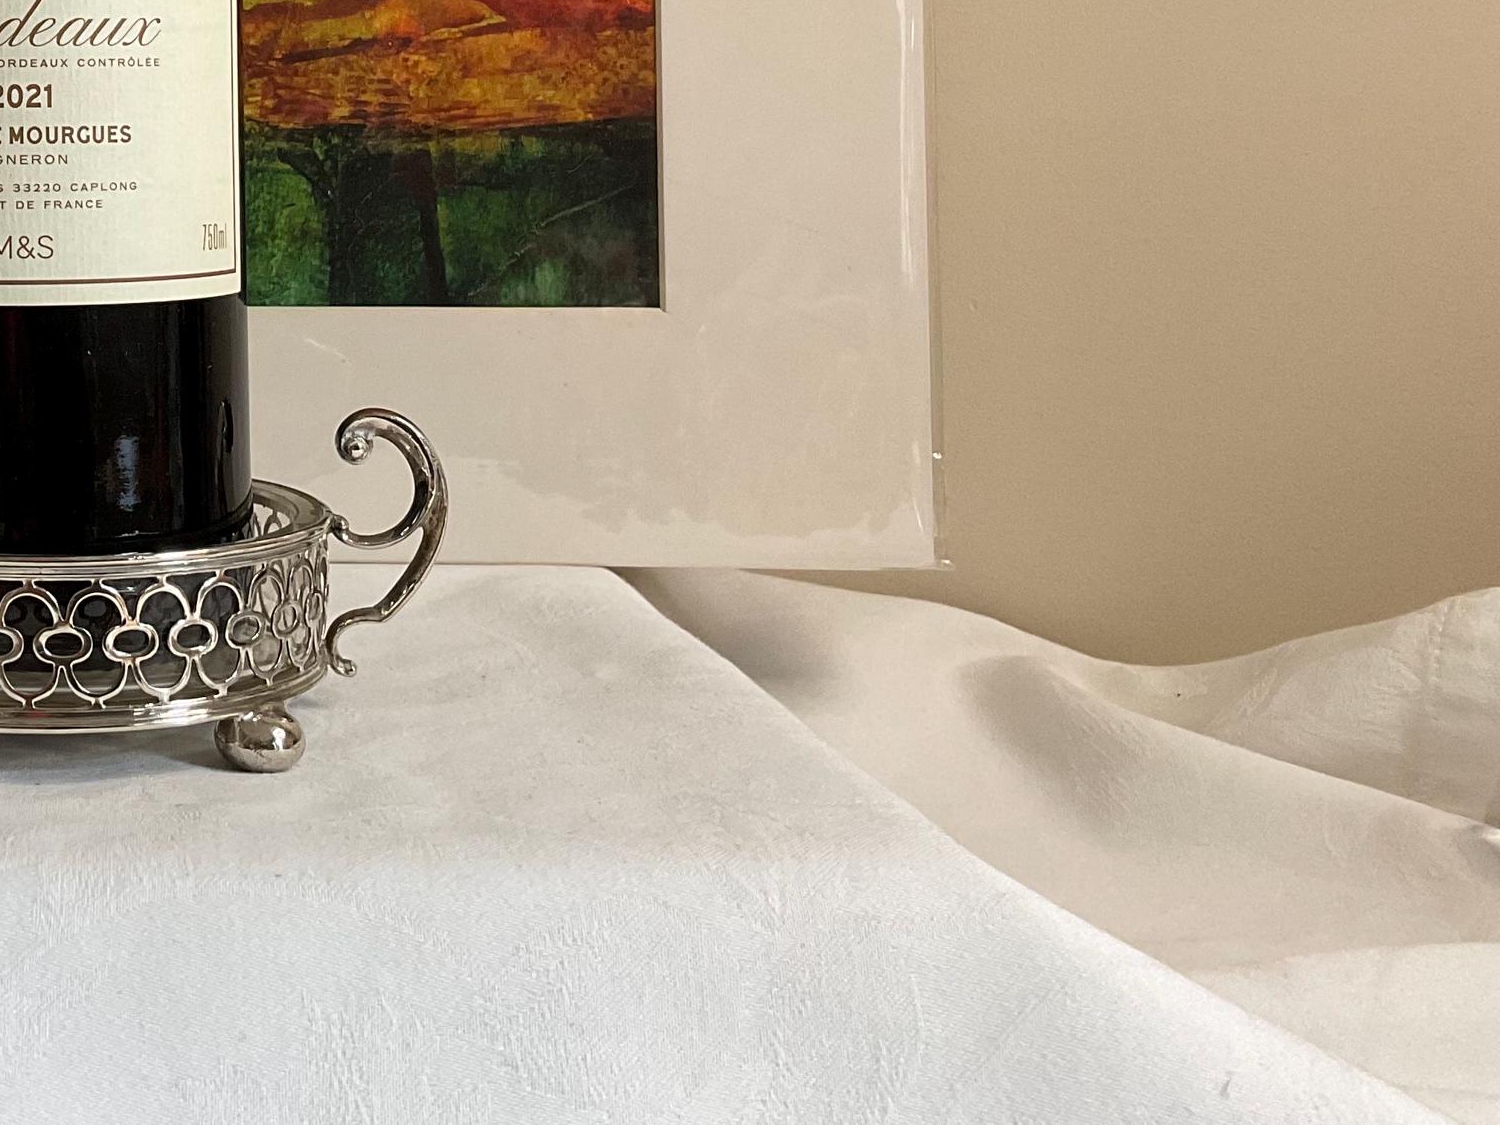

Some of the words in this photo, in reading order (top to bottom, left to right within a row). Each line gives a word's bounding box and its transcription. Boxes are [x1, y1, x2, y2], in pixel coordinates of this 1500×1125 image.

[76, 55, 161, 68] CONTRÔLÉE
[8, 124, 132, 145] MOURGUES
[12, 182, 62, 194] 33220
[69, 181, 138, 193] CAPLONG
[15, 200, 35, 210] DE
[43, 198, 104, 210] FRANCE
[201, 222, 228, 252] 750ml
